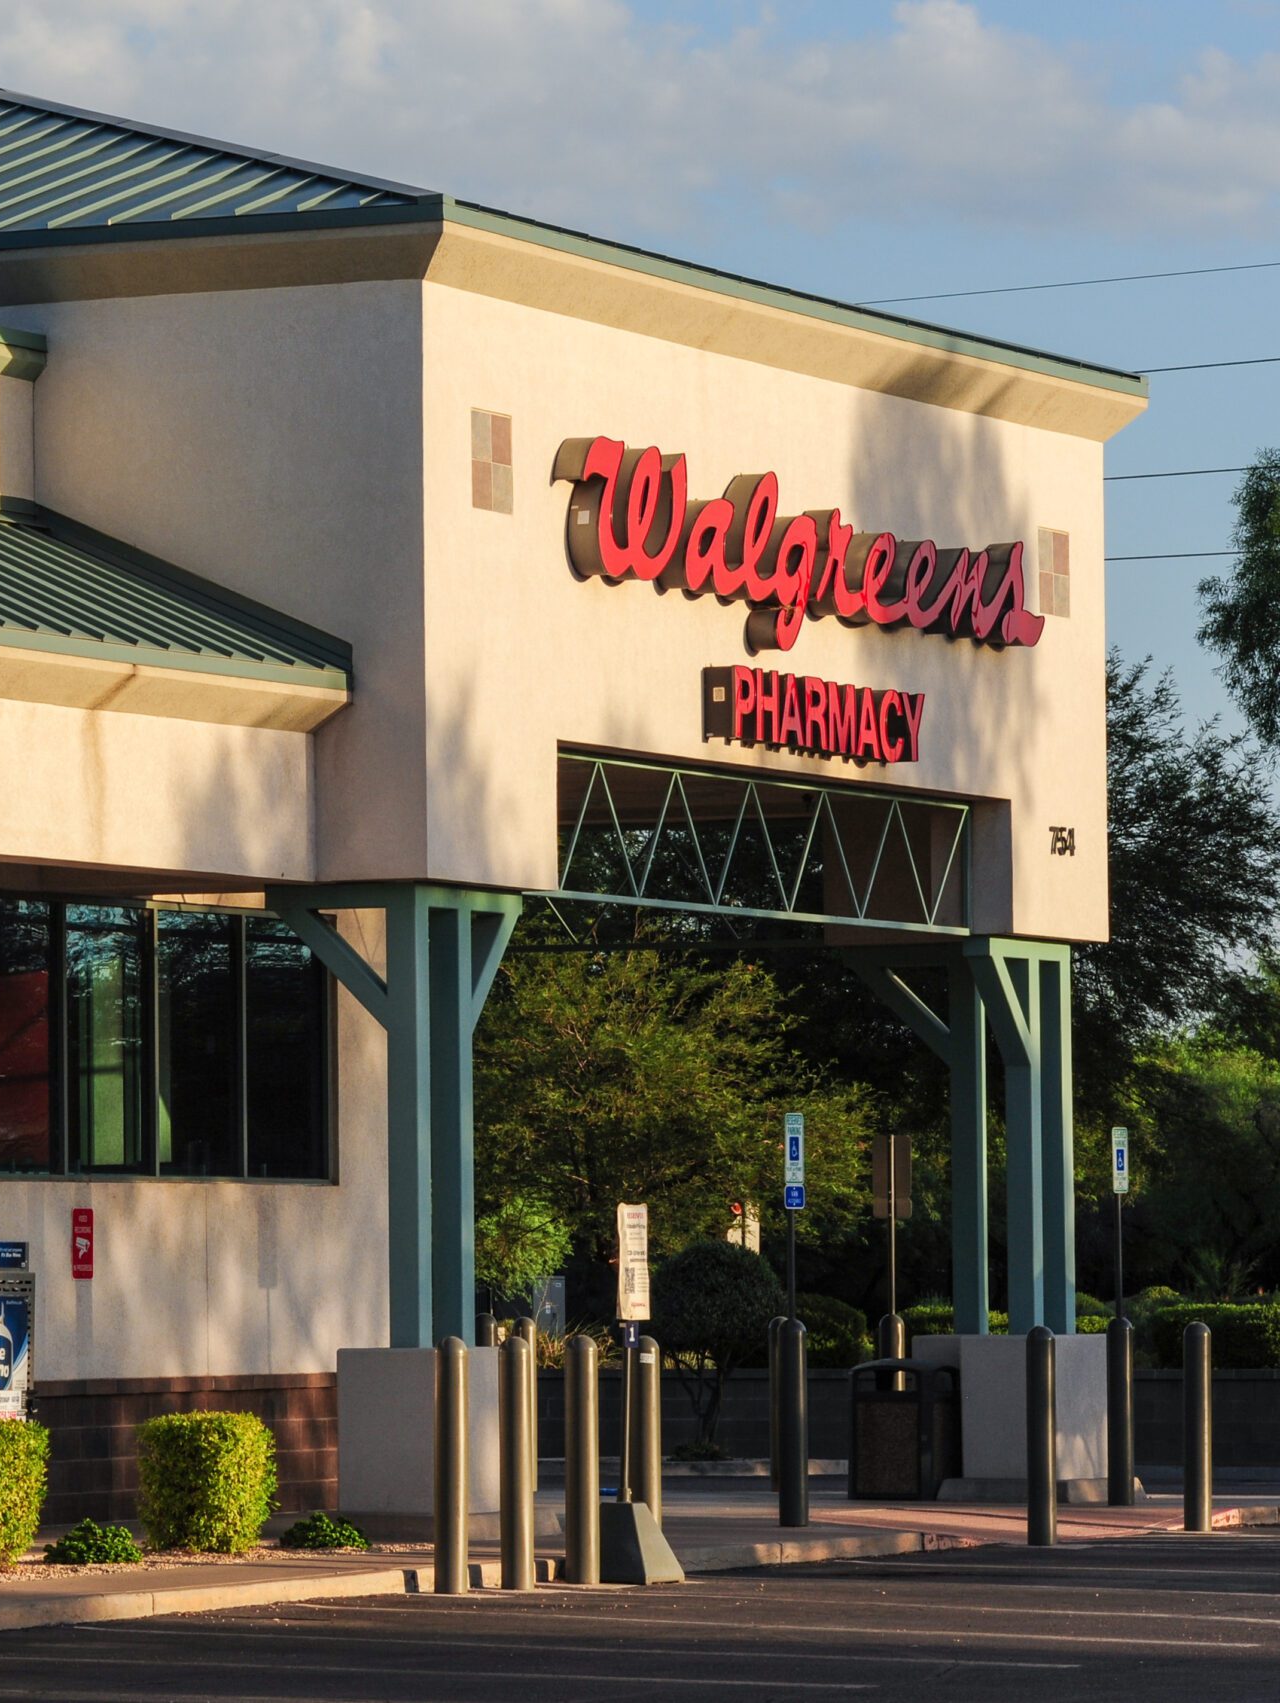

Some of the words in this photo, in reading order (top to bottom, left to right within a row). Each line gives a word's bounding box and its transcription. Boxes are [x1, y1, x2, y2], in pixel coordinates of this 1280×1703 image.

[568, 436, 1045, 651] Walgreens
[723, 665, 925, 764] PHARMACY
[1048, 826, 1076, 857] 754
[628, 1326, 636, 1343] 1
